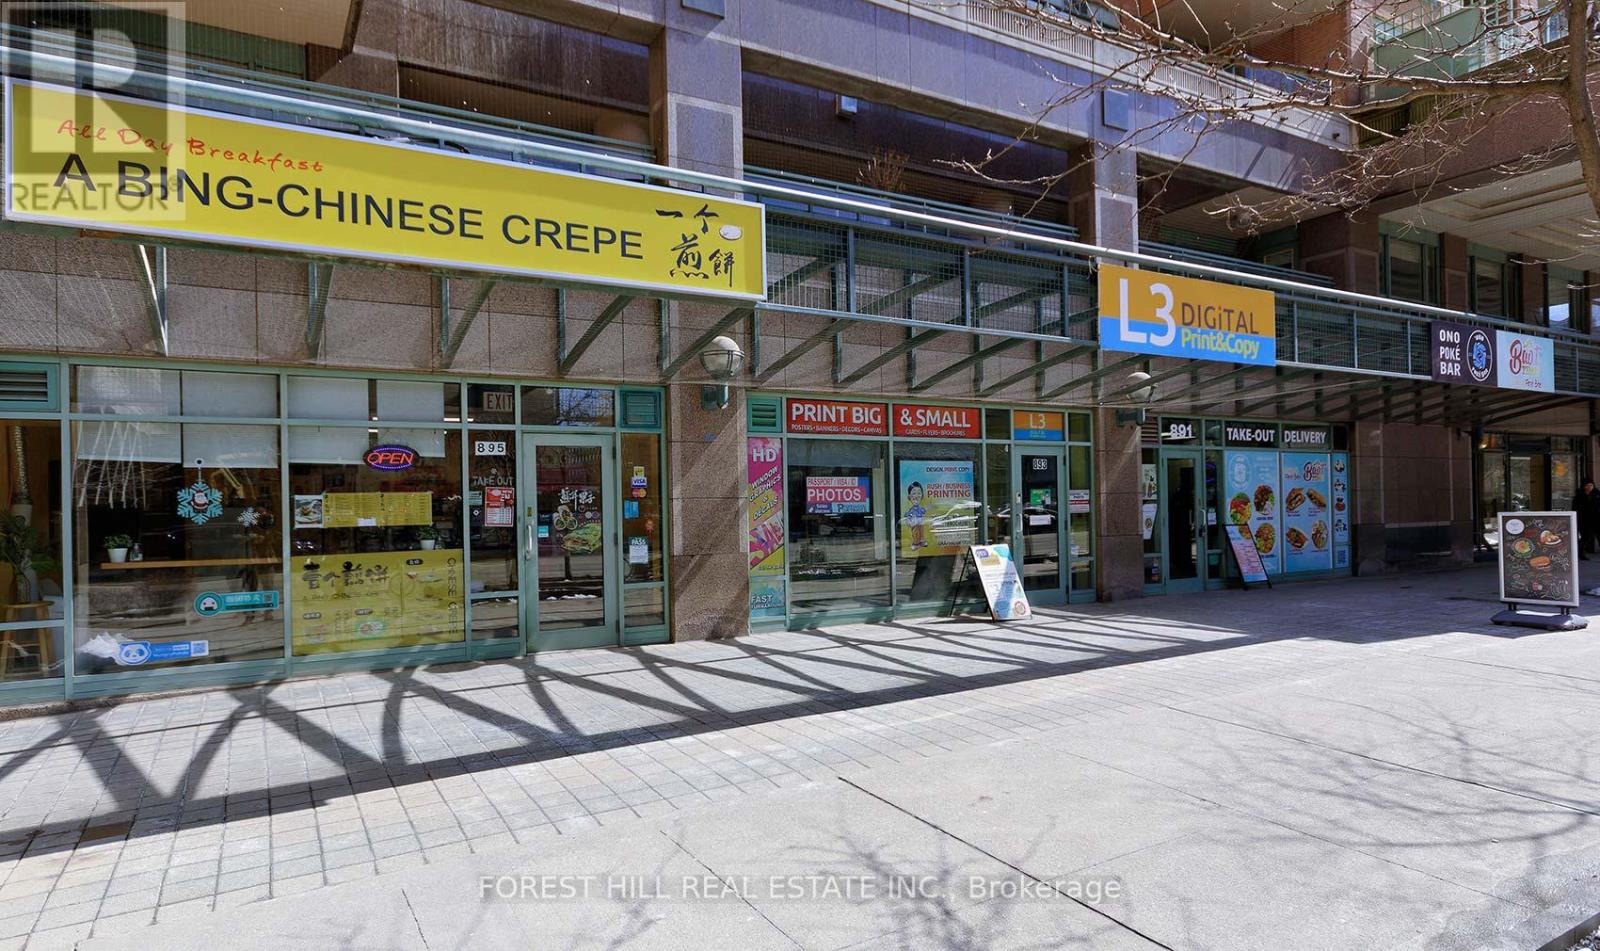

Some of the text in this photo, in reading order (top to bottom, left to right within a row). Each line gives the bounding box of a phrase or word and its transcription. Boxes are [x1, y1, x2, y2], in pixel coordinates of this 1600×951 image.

[57, 119, 325, 172] All Day Breakfast
[53, 152, 643, 259] A BING-CHINESE CREPE
[1119, 278, 1176, 347] L3
[1181, 327, 1260, 360] Print&Copy
[1439, 329, 1460, 344] ONO
[1440, 361, 1461, 377] BAR
[487, 393, 512, 410] EXIT
[792, 403, 881, 425] PRINT BIG
[900, 408, 971, 428] & SMALL
[1030, 413, 1046, 429] L3
[1170, 424, 1192, 438] 891
[1226, 427, 1275, 442] TAKE-OUT
[1284, 430, 1326, 444] DELIVERY
[477, 443, 505, 453] 895
[752, 448, 777, 462] HD
[367, 452, 413, 464] OPEN
[1033, 459, 1047, 470] 893
[472, 476, 514, 486] TAKE OUT
[752, 466, 778, 488] WINDOW
[750, 473, 781, 502] GRAPHICS
[945, 482, 970, 490] BUSINESS
[807, 488, 861, 501] PHOTOS
[927, 490, 971, 498] PRINTING
[751, 594, 773, 603] FAST
